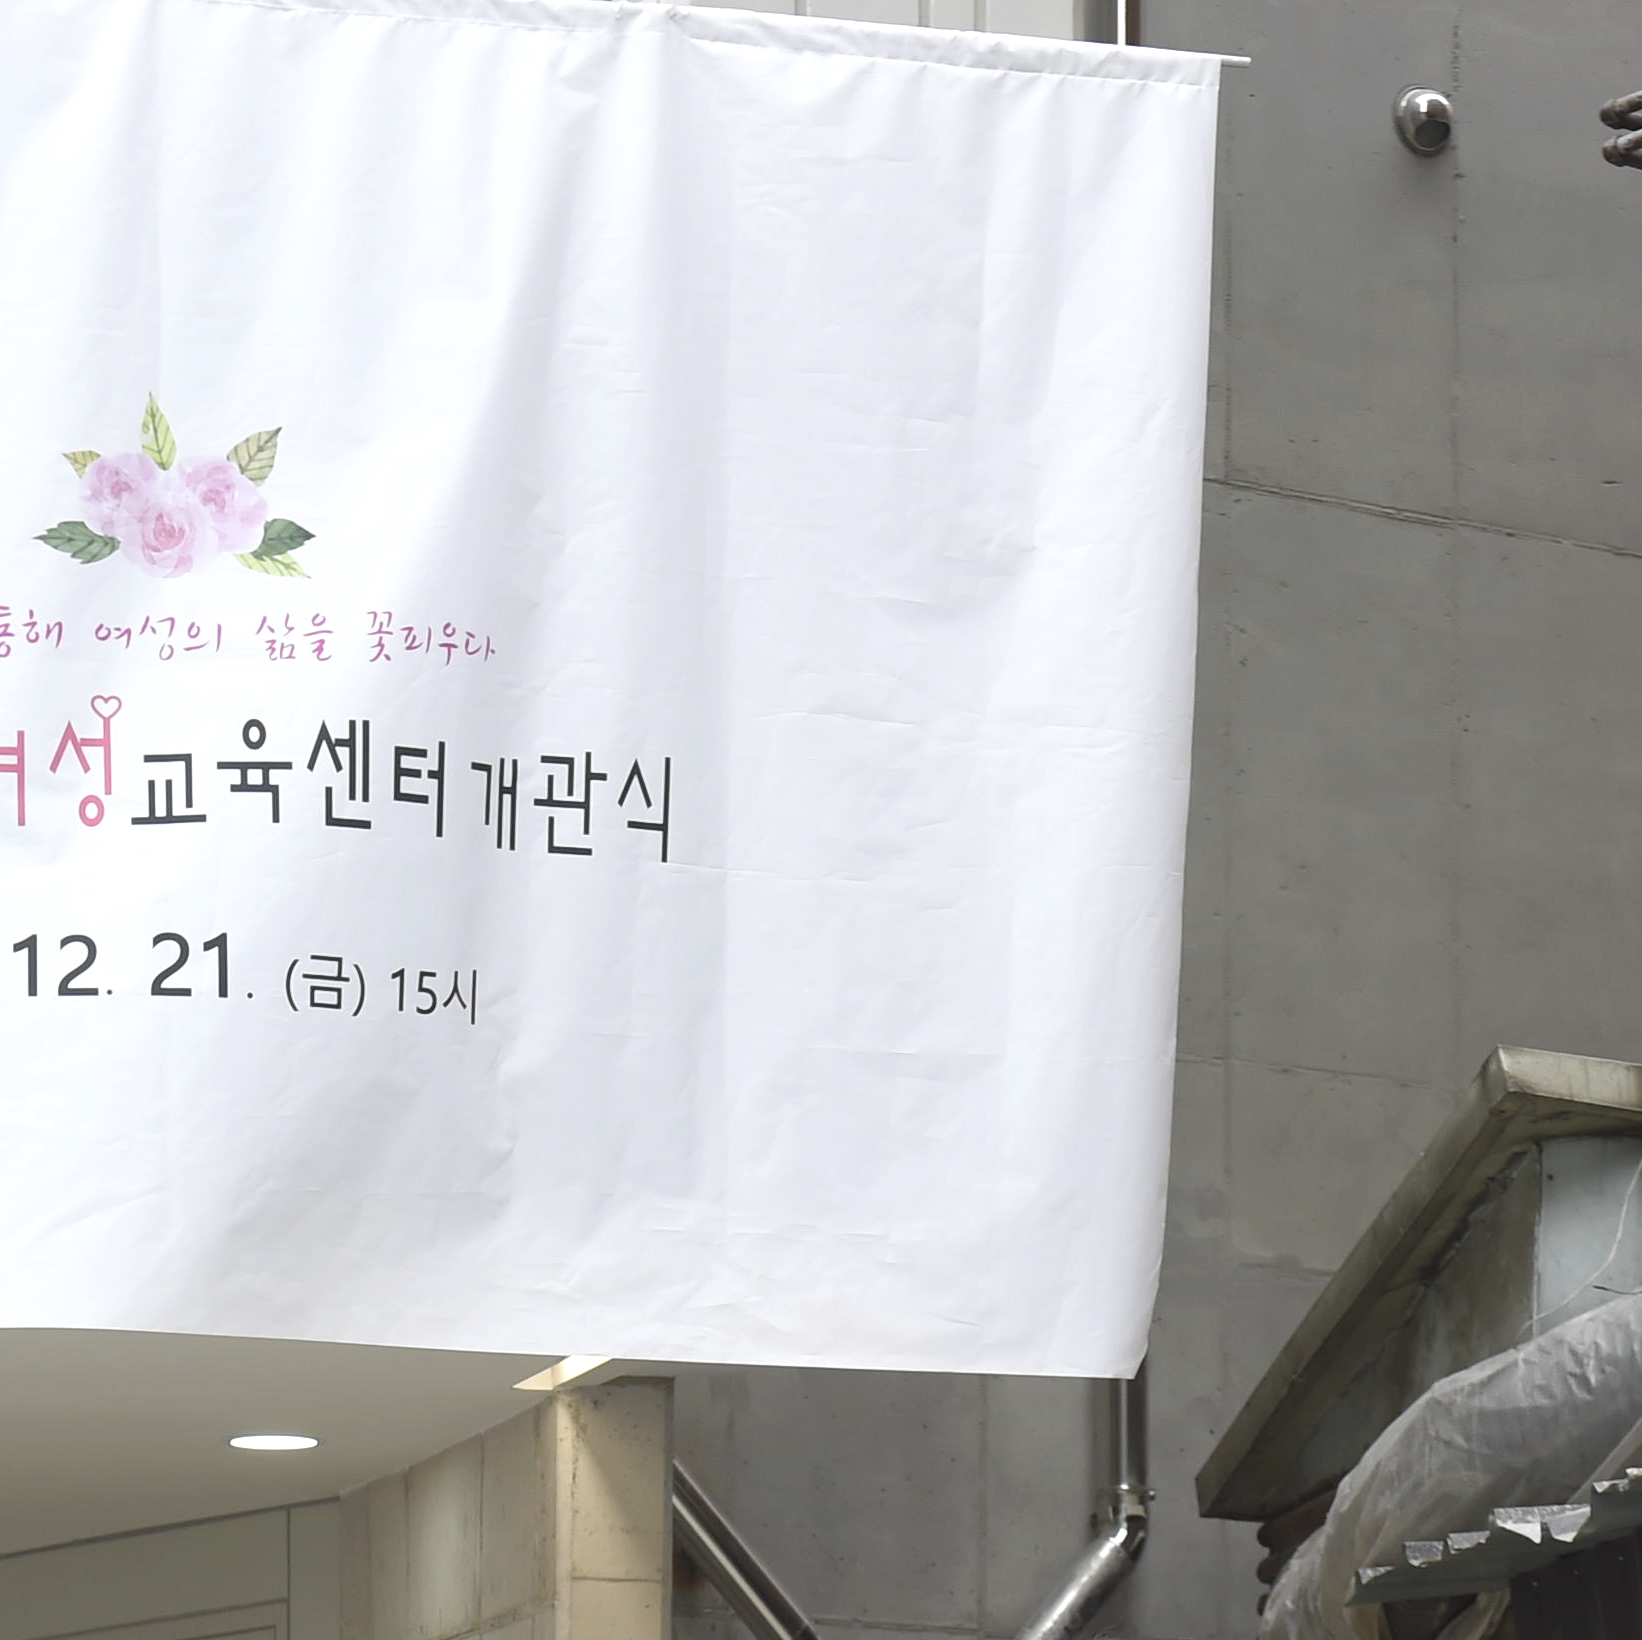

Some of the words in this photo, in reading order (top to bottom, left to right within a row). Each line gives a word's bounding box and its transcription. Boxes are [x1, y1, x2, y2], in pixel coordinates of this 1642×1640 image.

[94, 615, 222, 661] 여성의
[255, 612, 333, 662] 삶을
[367, 610, 496, 666] 꽃피우다
[12, 933, 114, 998] 12.
[150, 931, 254, 1000] 21.
[284, 954, 366, 1017] (금)
[390, 967, 478, 1026] 15시
